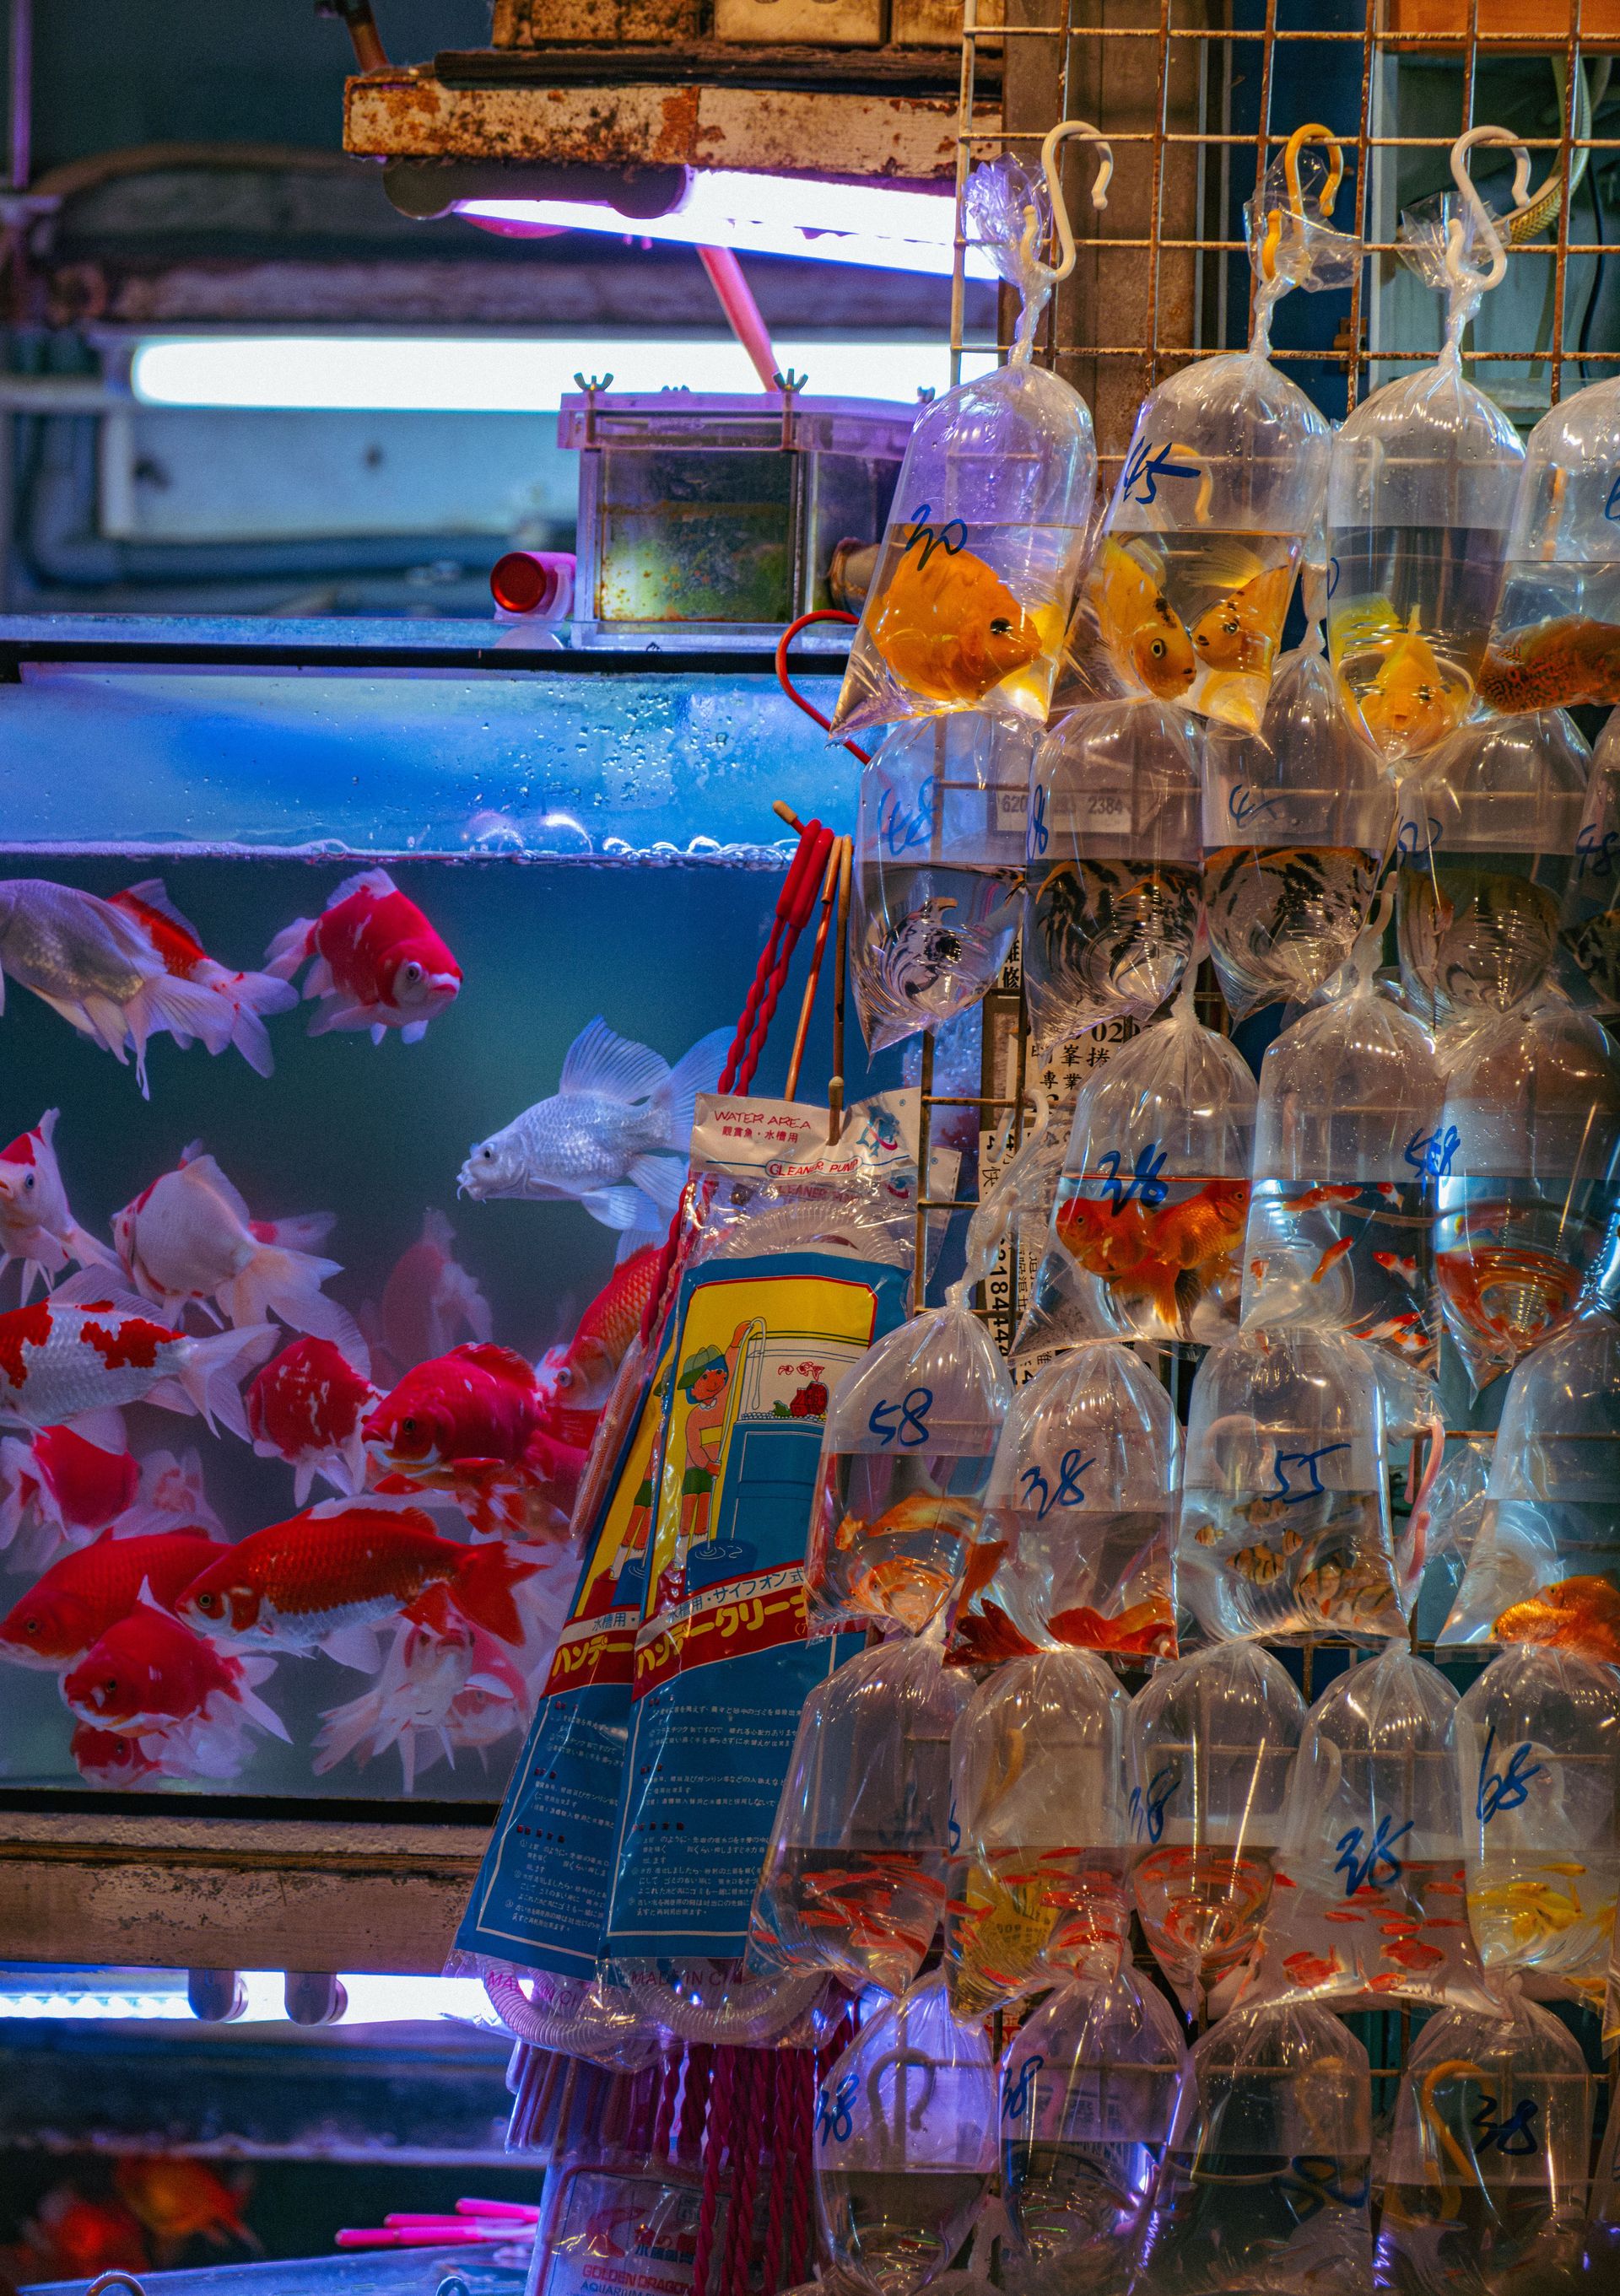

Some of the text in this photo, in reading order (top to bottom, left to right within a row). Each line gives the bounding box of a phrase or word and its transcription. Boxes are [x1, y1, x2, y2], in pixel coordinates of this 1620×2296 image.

[715, 1110, 812, 1129] WATER AREA
[770, 1161, 824, 1177] CLEANER
[869, 1388, 933, 1447] 58
[1020, 1448, 1096, 1519] 38
[1263, 1443, 1352, 1504] 55
[1473, 2095, 1539, 2157] 38
[582, 2264, 634, 2286] GOLDEN
